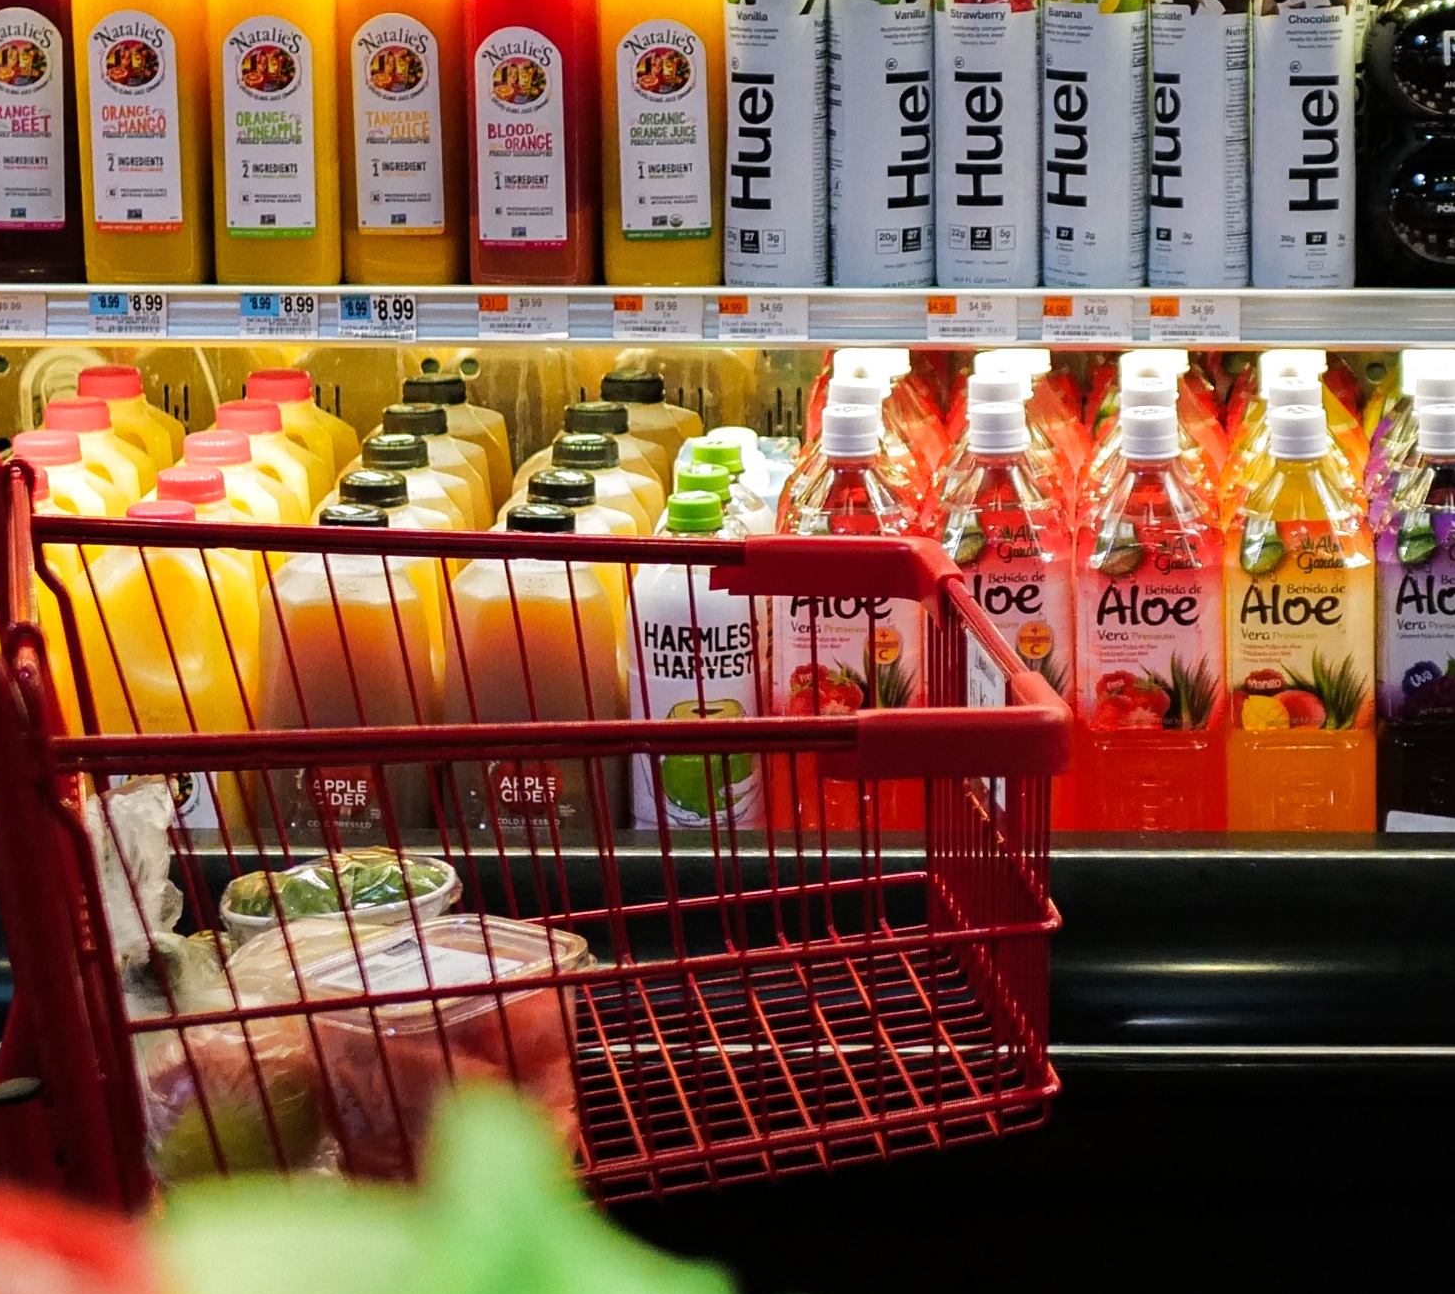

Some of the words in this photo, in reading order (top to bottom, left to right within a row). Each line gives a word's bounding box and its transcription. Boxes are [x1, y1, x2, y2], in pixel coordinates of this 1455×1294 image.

[736, 11, 768, 23] Vanilla
[950, 9, 1007, 23] Strawberry
[1048, 9, 1083, 21] Banana
[1288, 13, 1341, 26] Chocolate
[10, 115, 52, 133] BEET
[117, 115, 166, 134] MANGO
[236, 111, 288, 128] ORANGE
[640, 112, 686, 126] ORGANIC
[246, 122, 302, 141] PINEAPPLE
[488, 122, 534, 139] BLOOD
[630, 125, 669, 140] ORANGE
[671, 125, 697, 139] JUICE
[956, 71, 1004, 207] Huel
[1046, 69, 1089, 207] Huel
[504, 133, 553, 151] ORANGE
[731, 71, 775, 211] Huel
[1289, 74, 1341, 213] Huel
[2, 155, 49, 169] INGREDIENTS
[1096, 580, 1200, 626] Aloe
[1240, 580, 1343, 625] Aloe
[644, 621, 758, 653] HARMLES
[1098, 629, 1130, 642] Vera
[1240, 628, 1271, 641] Vera
[1248, 675, 1283, 691] Mango
[1408, 669, 1433, 689] Uva
